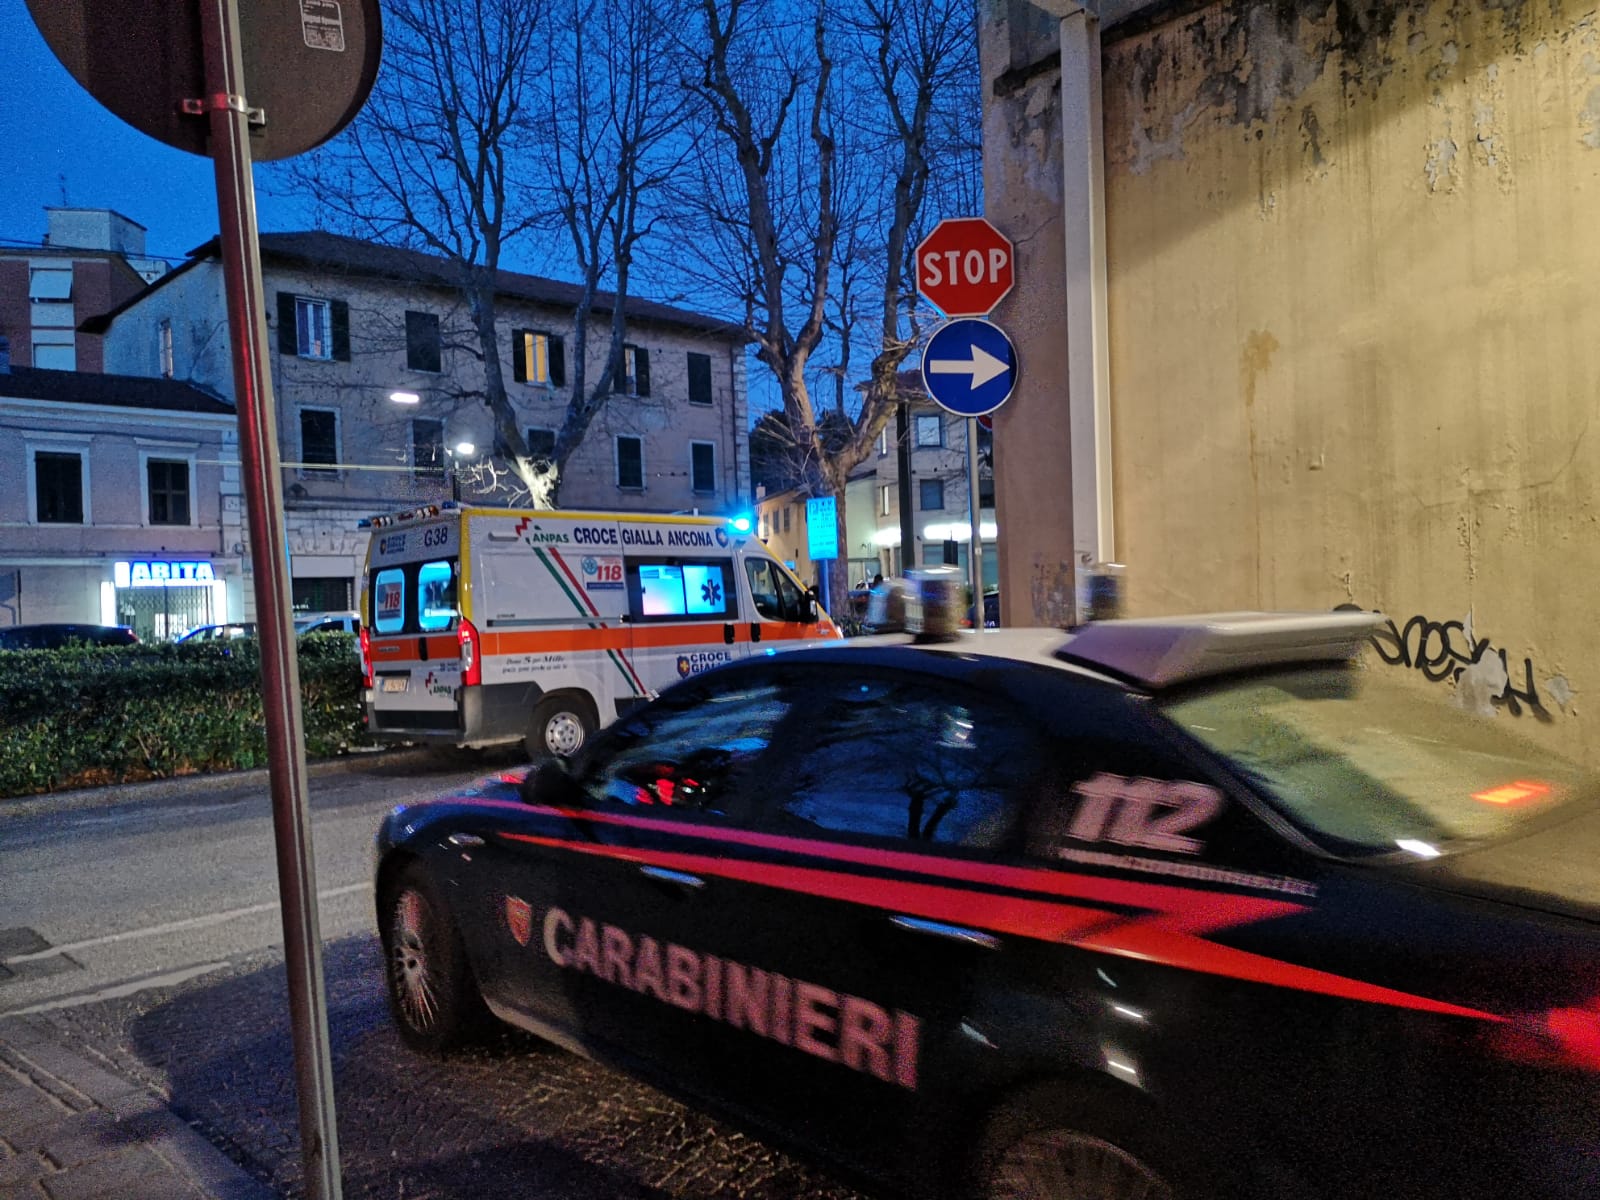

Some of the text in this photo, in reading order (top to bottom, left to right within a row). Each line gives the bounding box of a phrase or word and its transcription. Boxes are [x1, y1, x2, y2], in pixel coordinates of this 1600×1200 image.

[923, 249, 1008, 287] STOP
[424, 526, 448, 547] G38
[532, 532, 570, 543] ANPAS
[573, 527, 713, 547] CROCE GIALLA ANCONA
[131, 560, 215, 580] ABITA
[597, 565, 622, 581] 118
[385, 591, 400, 609] 118
[543, 906, 922, 1091] CARABINIERI
